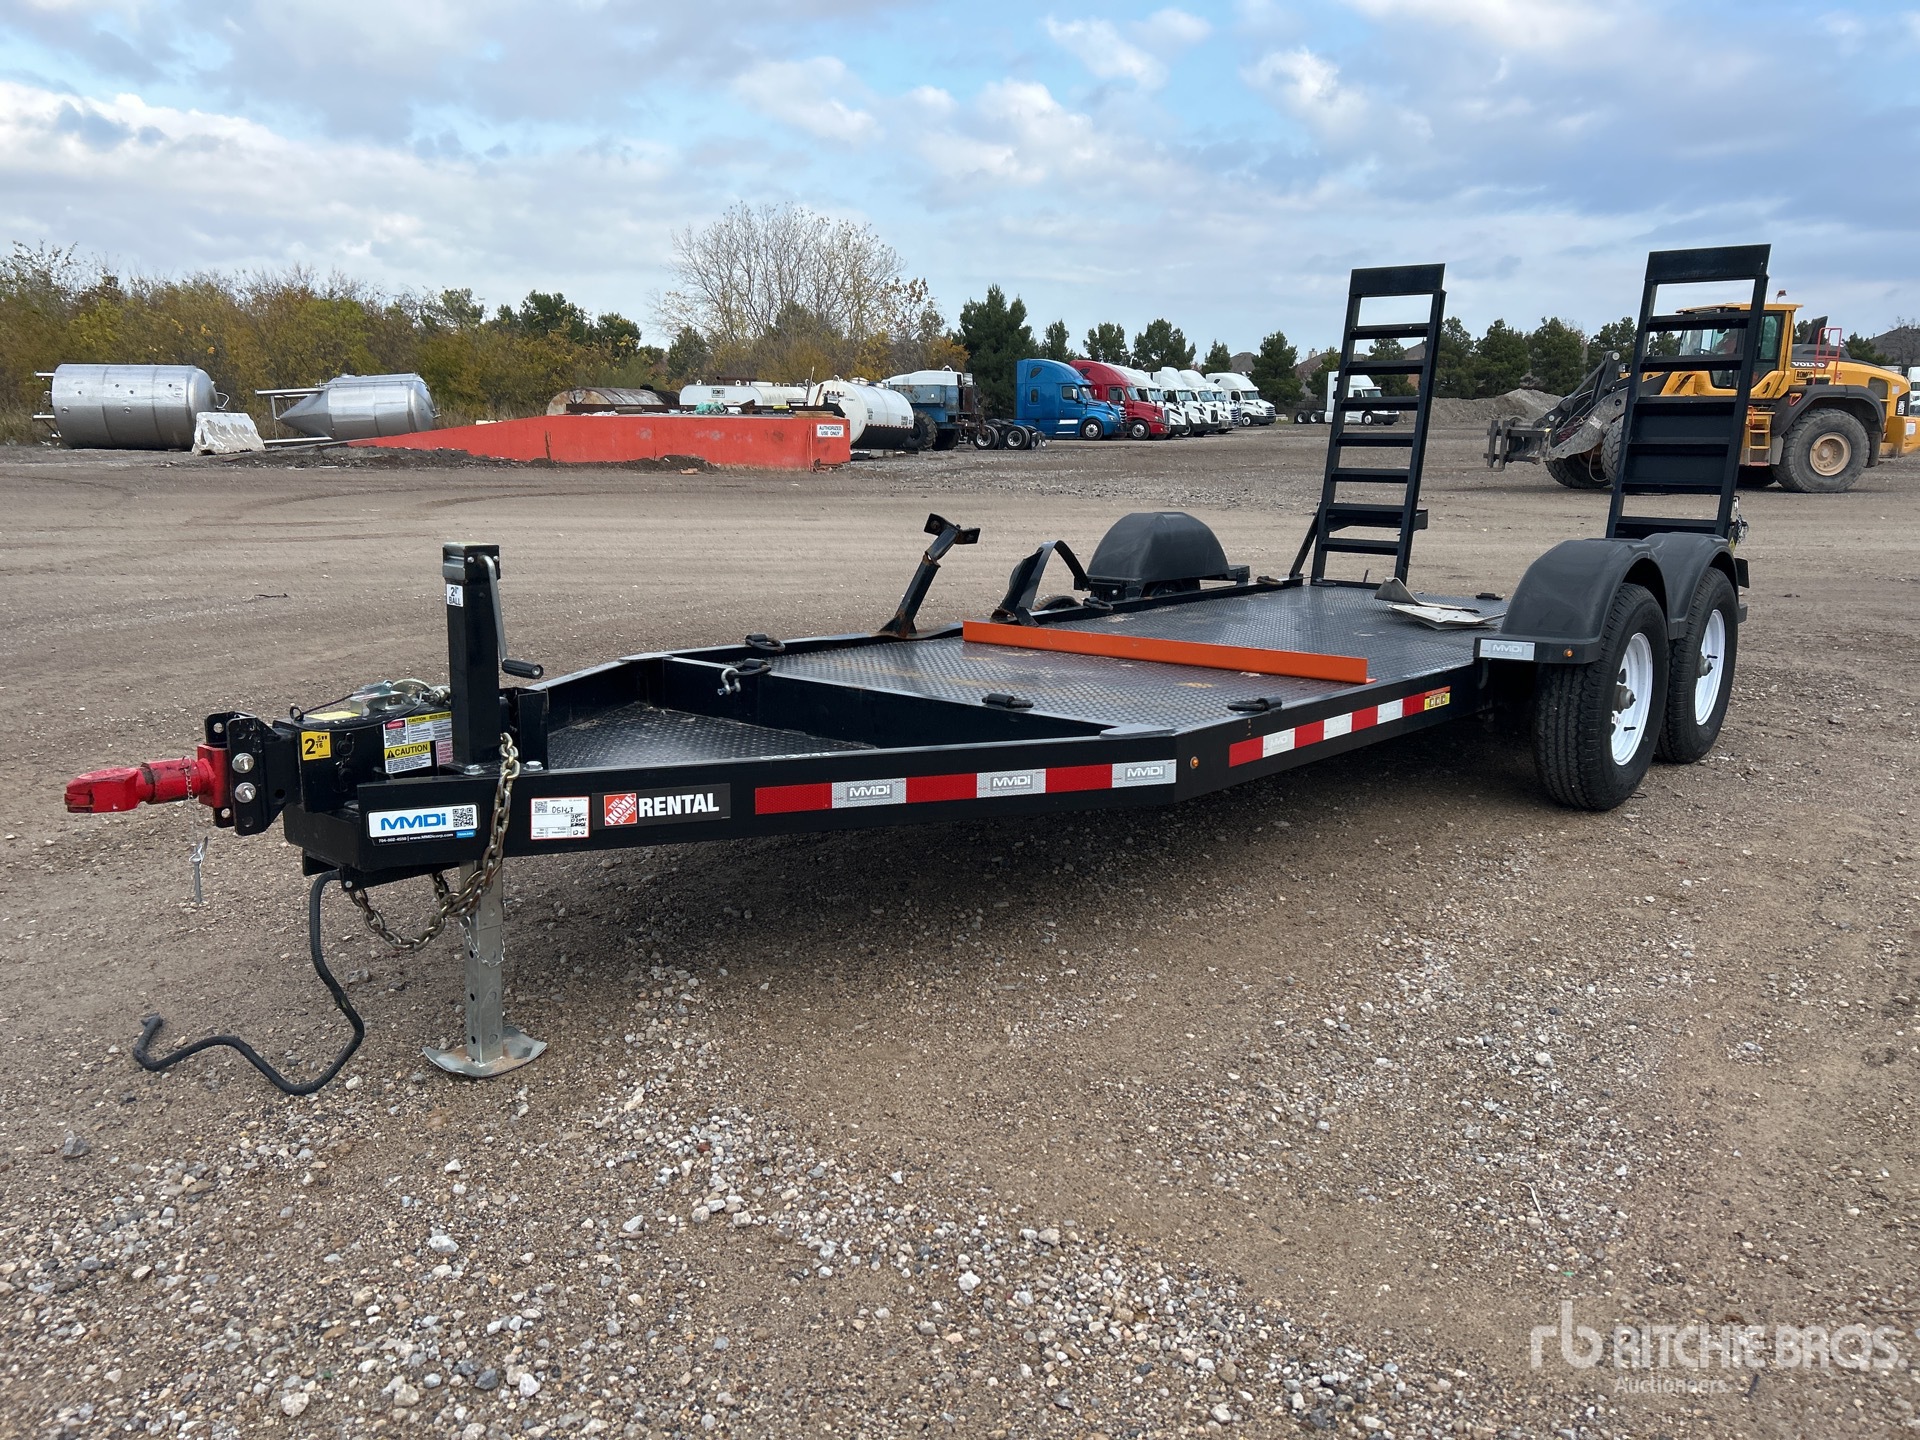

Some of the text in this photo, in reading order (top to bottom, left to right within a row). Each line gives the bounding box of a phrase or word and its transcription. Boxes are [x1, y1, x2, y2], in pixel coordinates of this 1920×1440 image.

[449, 597, 461, 605] BALL
[394, 744, 428, 756] CAUTION
[605, 793, 637, 825] HOME
[608, 798, 621, 811] THE
[638, 793, 720, 818] RENTAL
[618, 805, 637, 824] DEPOT
